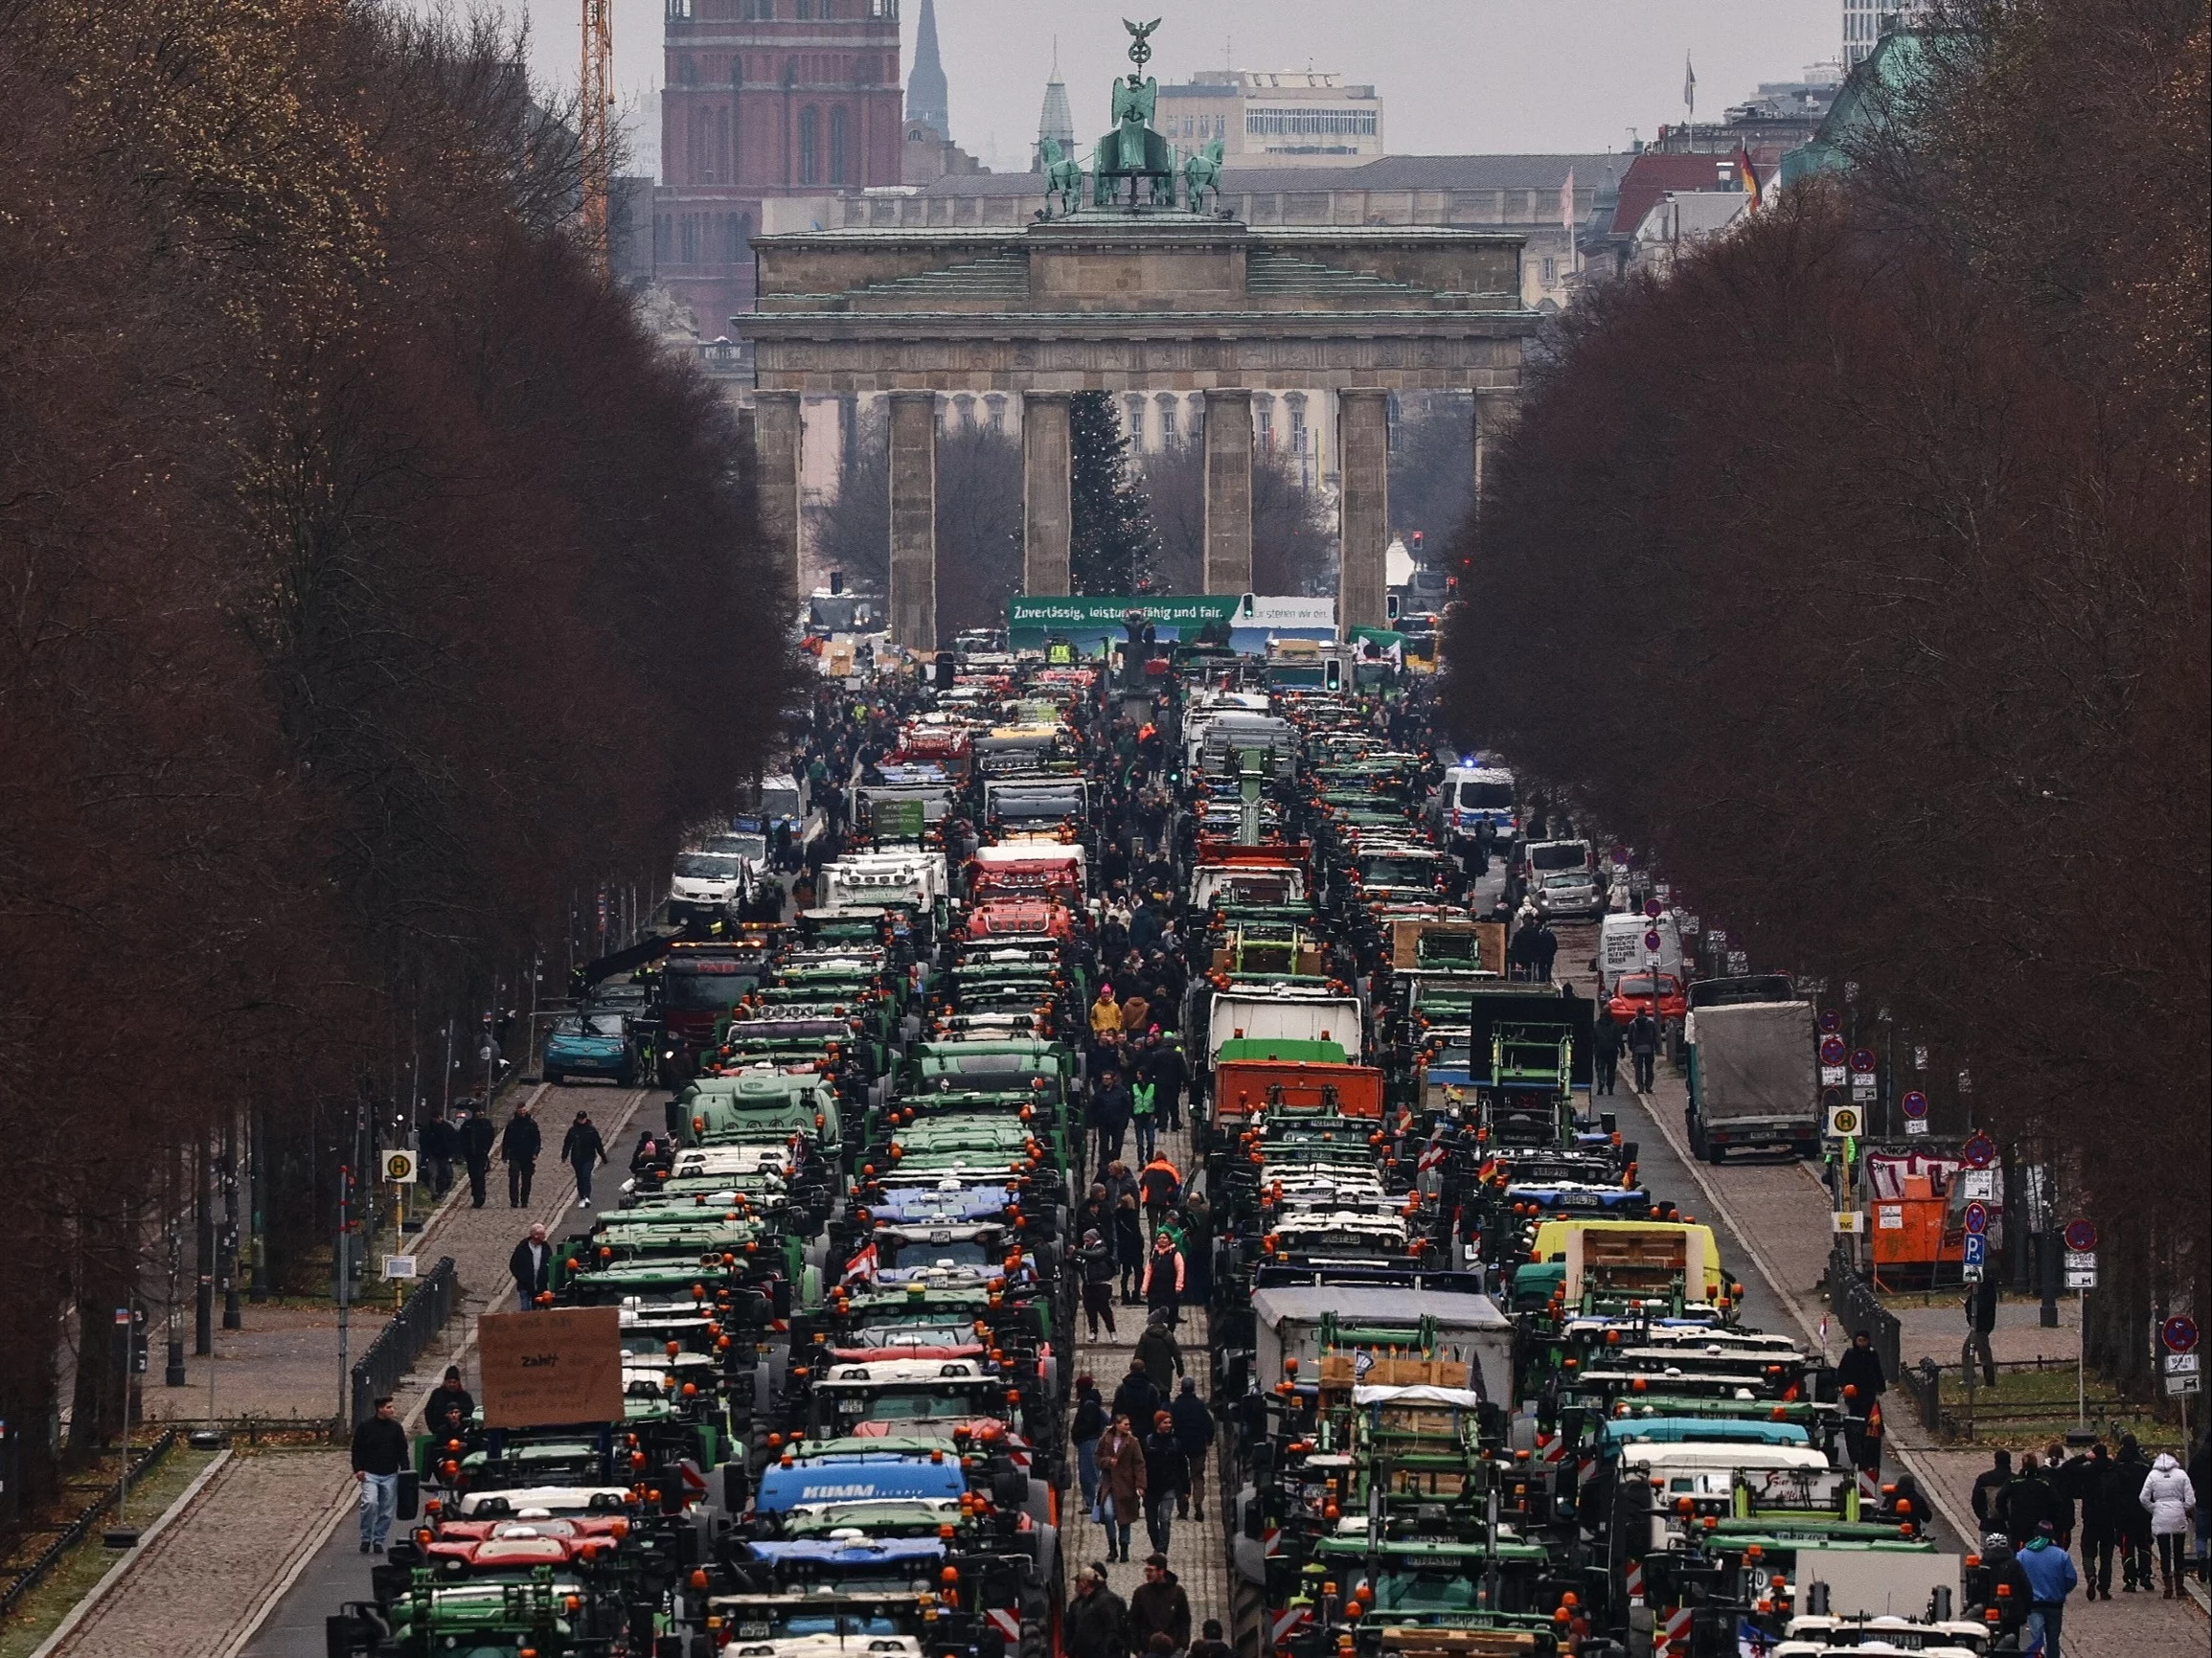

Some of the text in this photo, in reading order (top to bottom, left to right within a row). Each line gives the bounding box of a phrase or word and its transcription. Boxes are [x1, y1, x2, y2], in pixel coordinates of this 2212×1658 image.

[1014, 606, 1223, 621] Zuverlässig, leistunfähig und fair.
[1298, 610, 1312, 619] wir
[1967, 1237, 1978, 1261] P
[802, 1485, 875, 1499] KUMM
